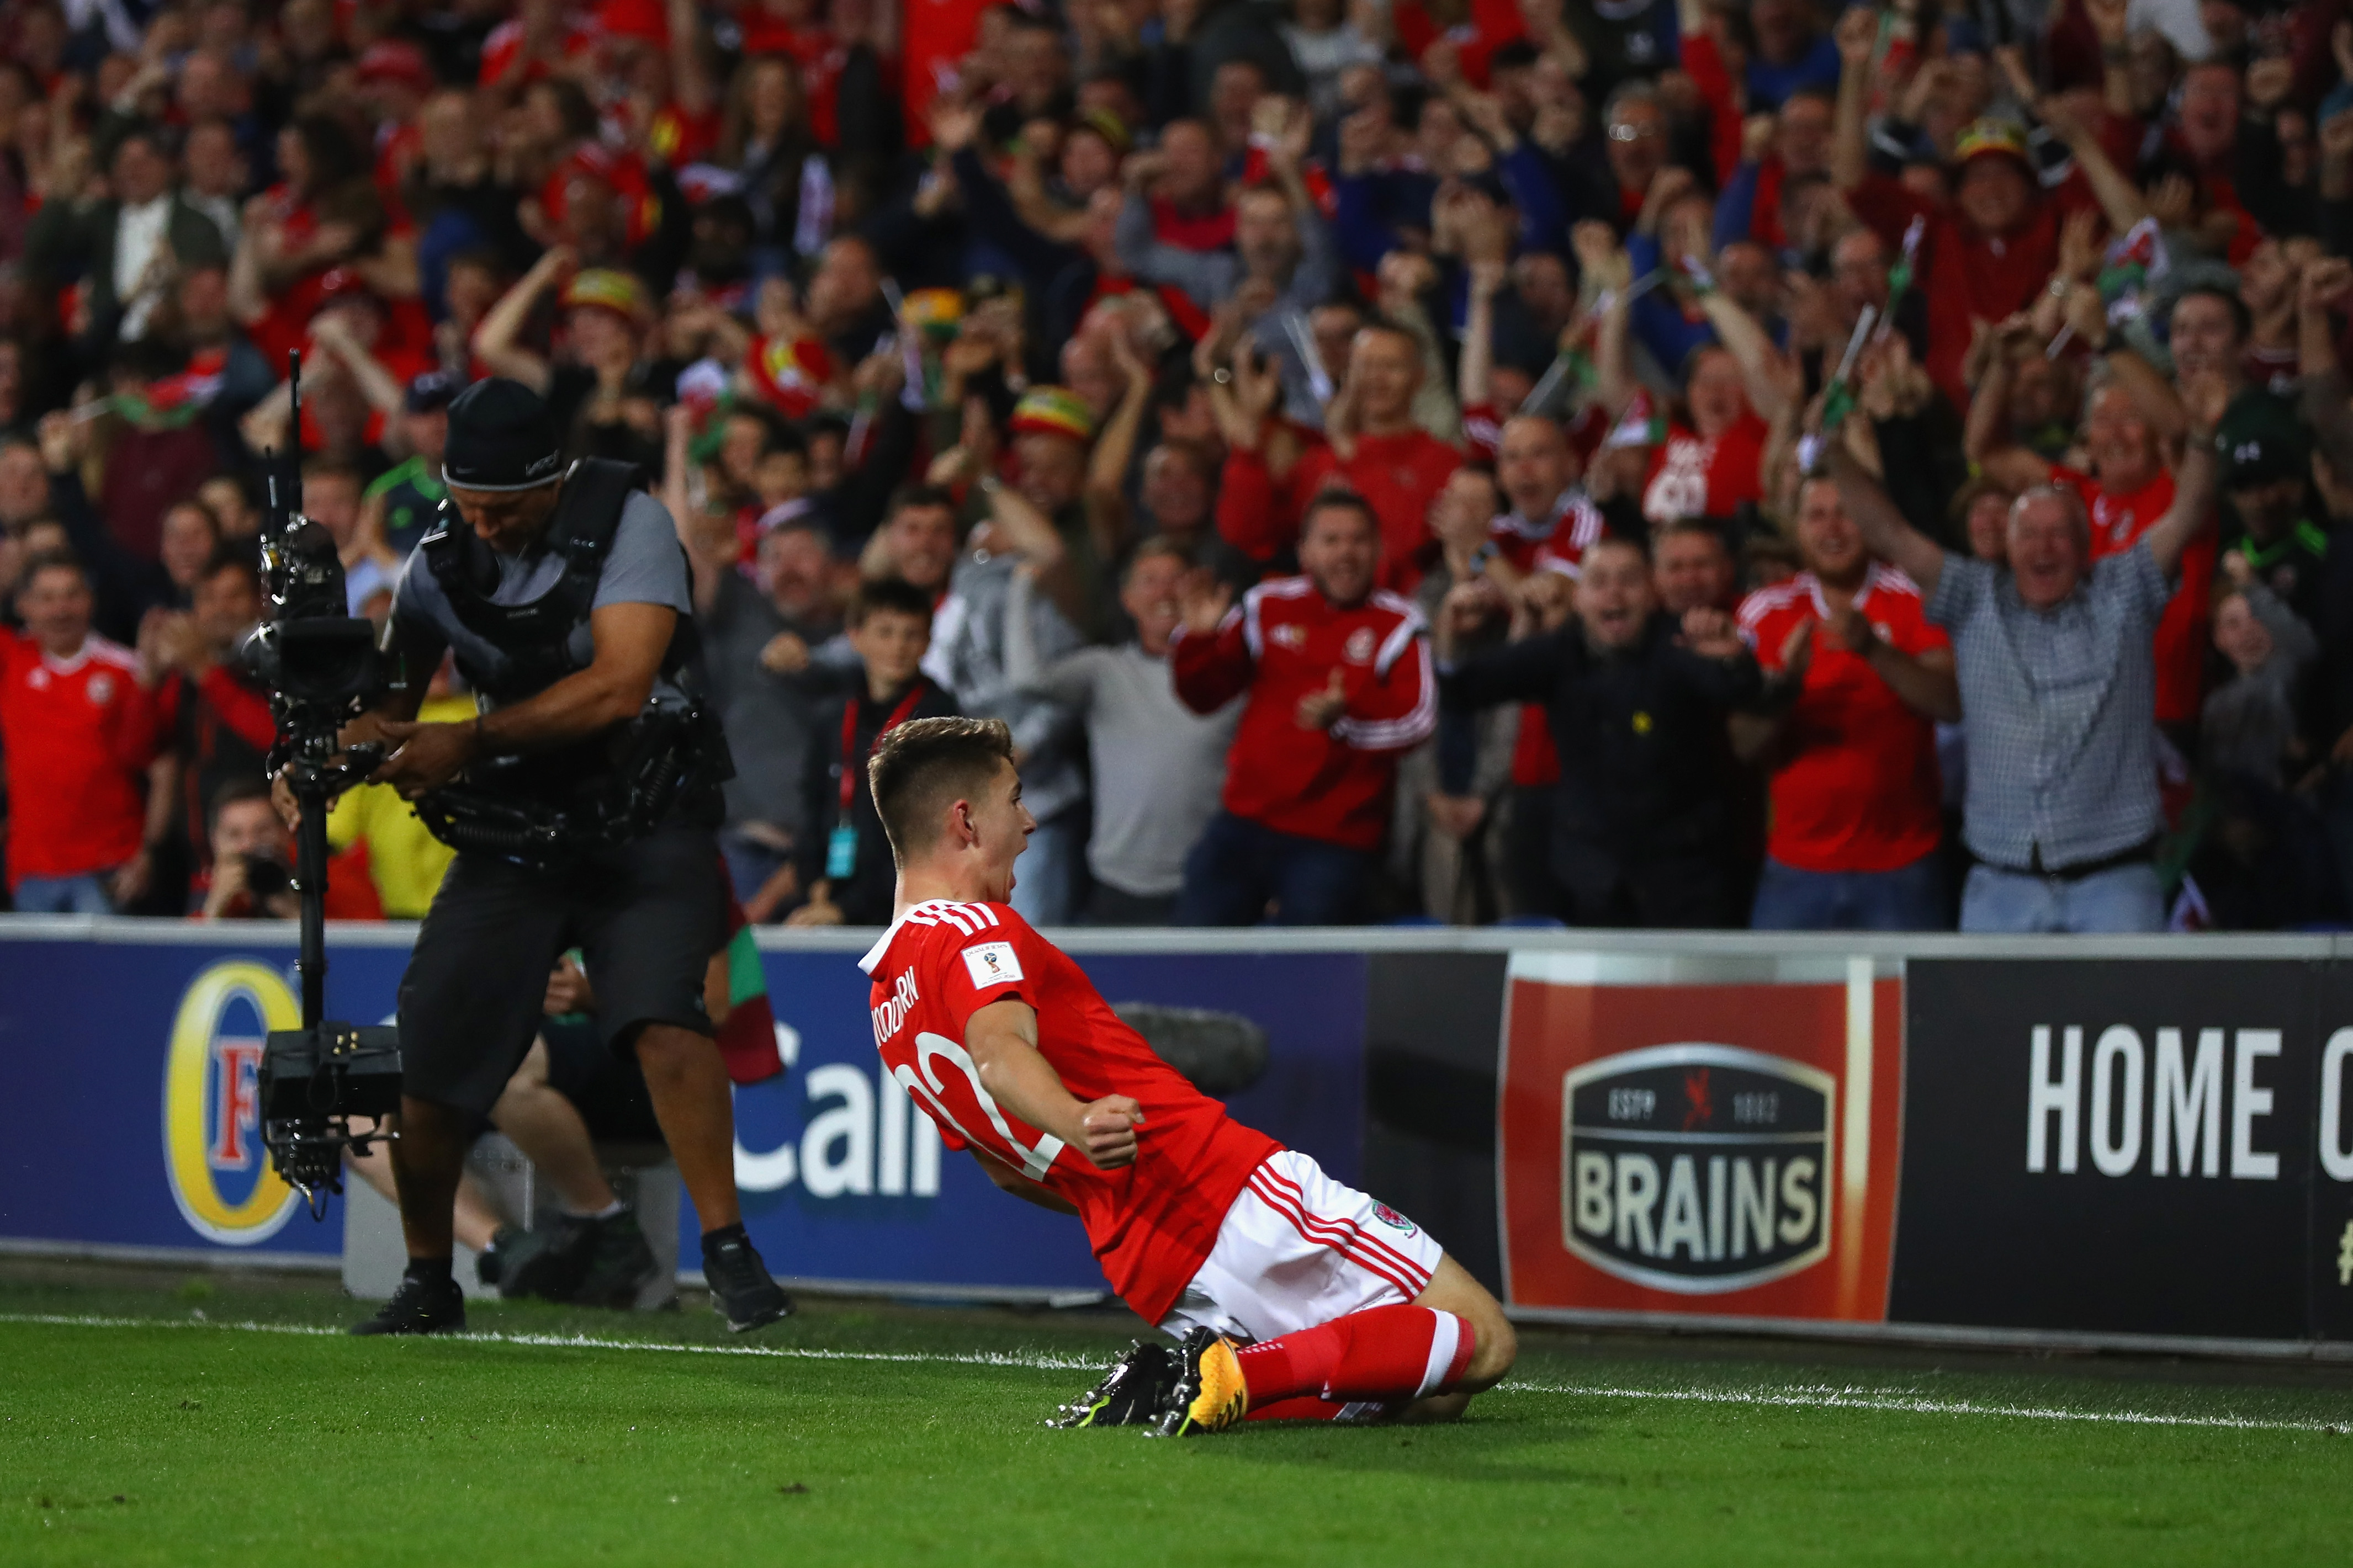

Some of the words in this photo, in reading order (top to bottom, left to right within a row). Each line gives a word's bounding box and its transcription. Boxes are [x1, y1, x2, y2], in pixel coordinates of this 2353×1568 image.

[966, 944, 1008, 956] QUALIFIERS
[2026, 1023, 2282, 1181] HOME
[1574, 1151, 1817, 1262] BRAINS
